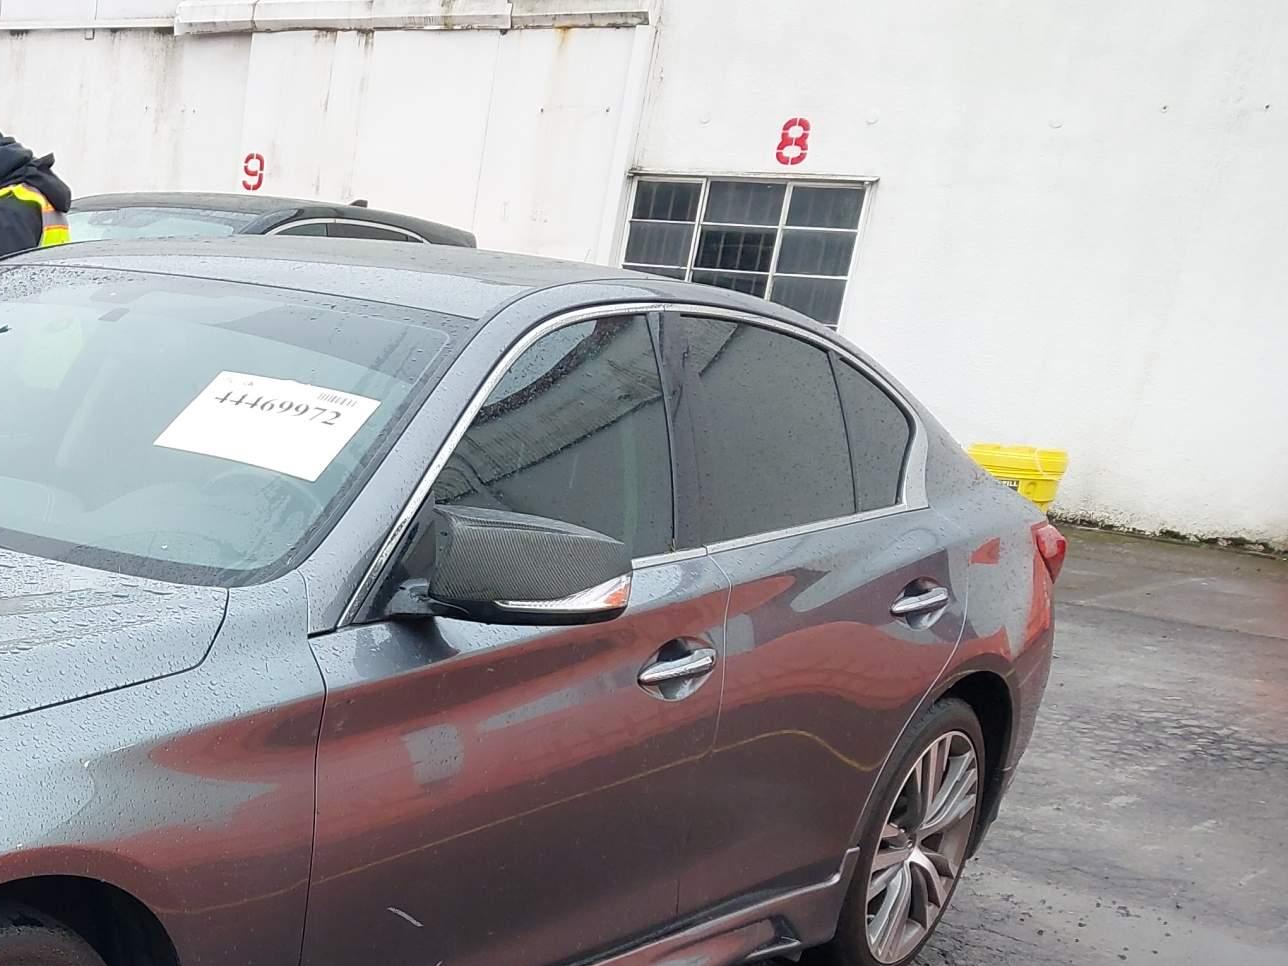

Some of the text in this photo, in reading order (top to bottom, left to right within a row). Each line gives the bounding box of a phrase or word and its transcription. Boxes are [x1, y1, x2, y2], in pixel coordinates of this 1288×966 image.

[775, 117, 810, 166] 8
[242, 153, 265, 191] 9
[214, 391, 342, 426] 44469972
